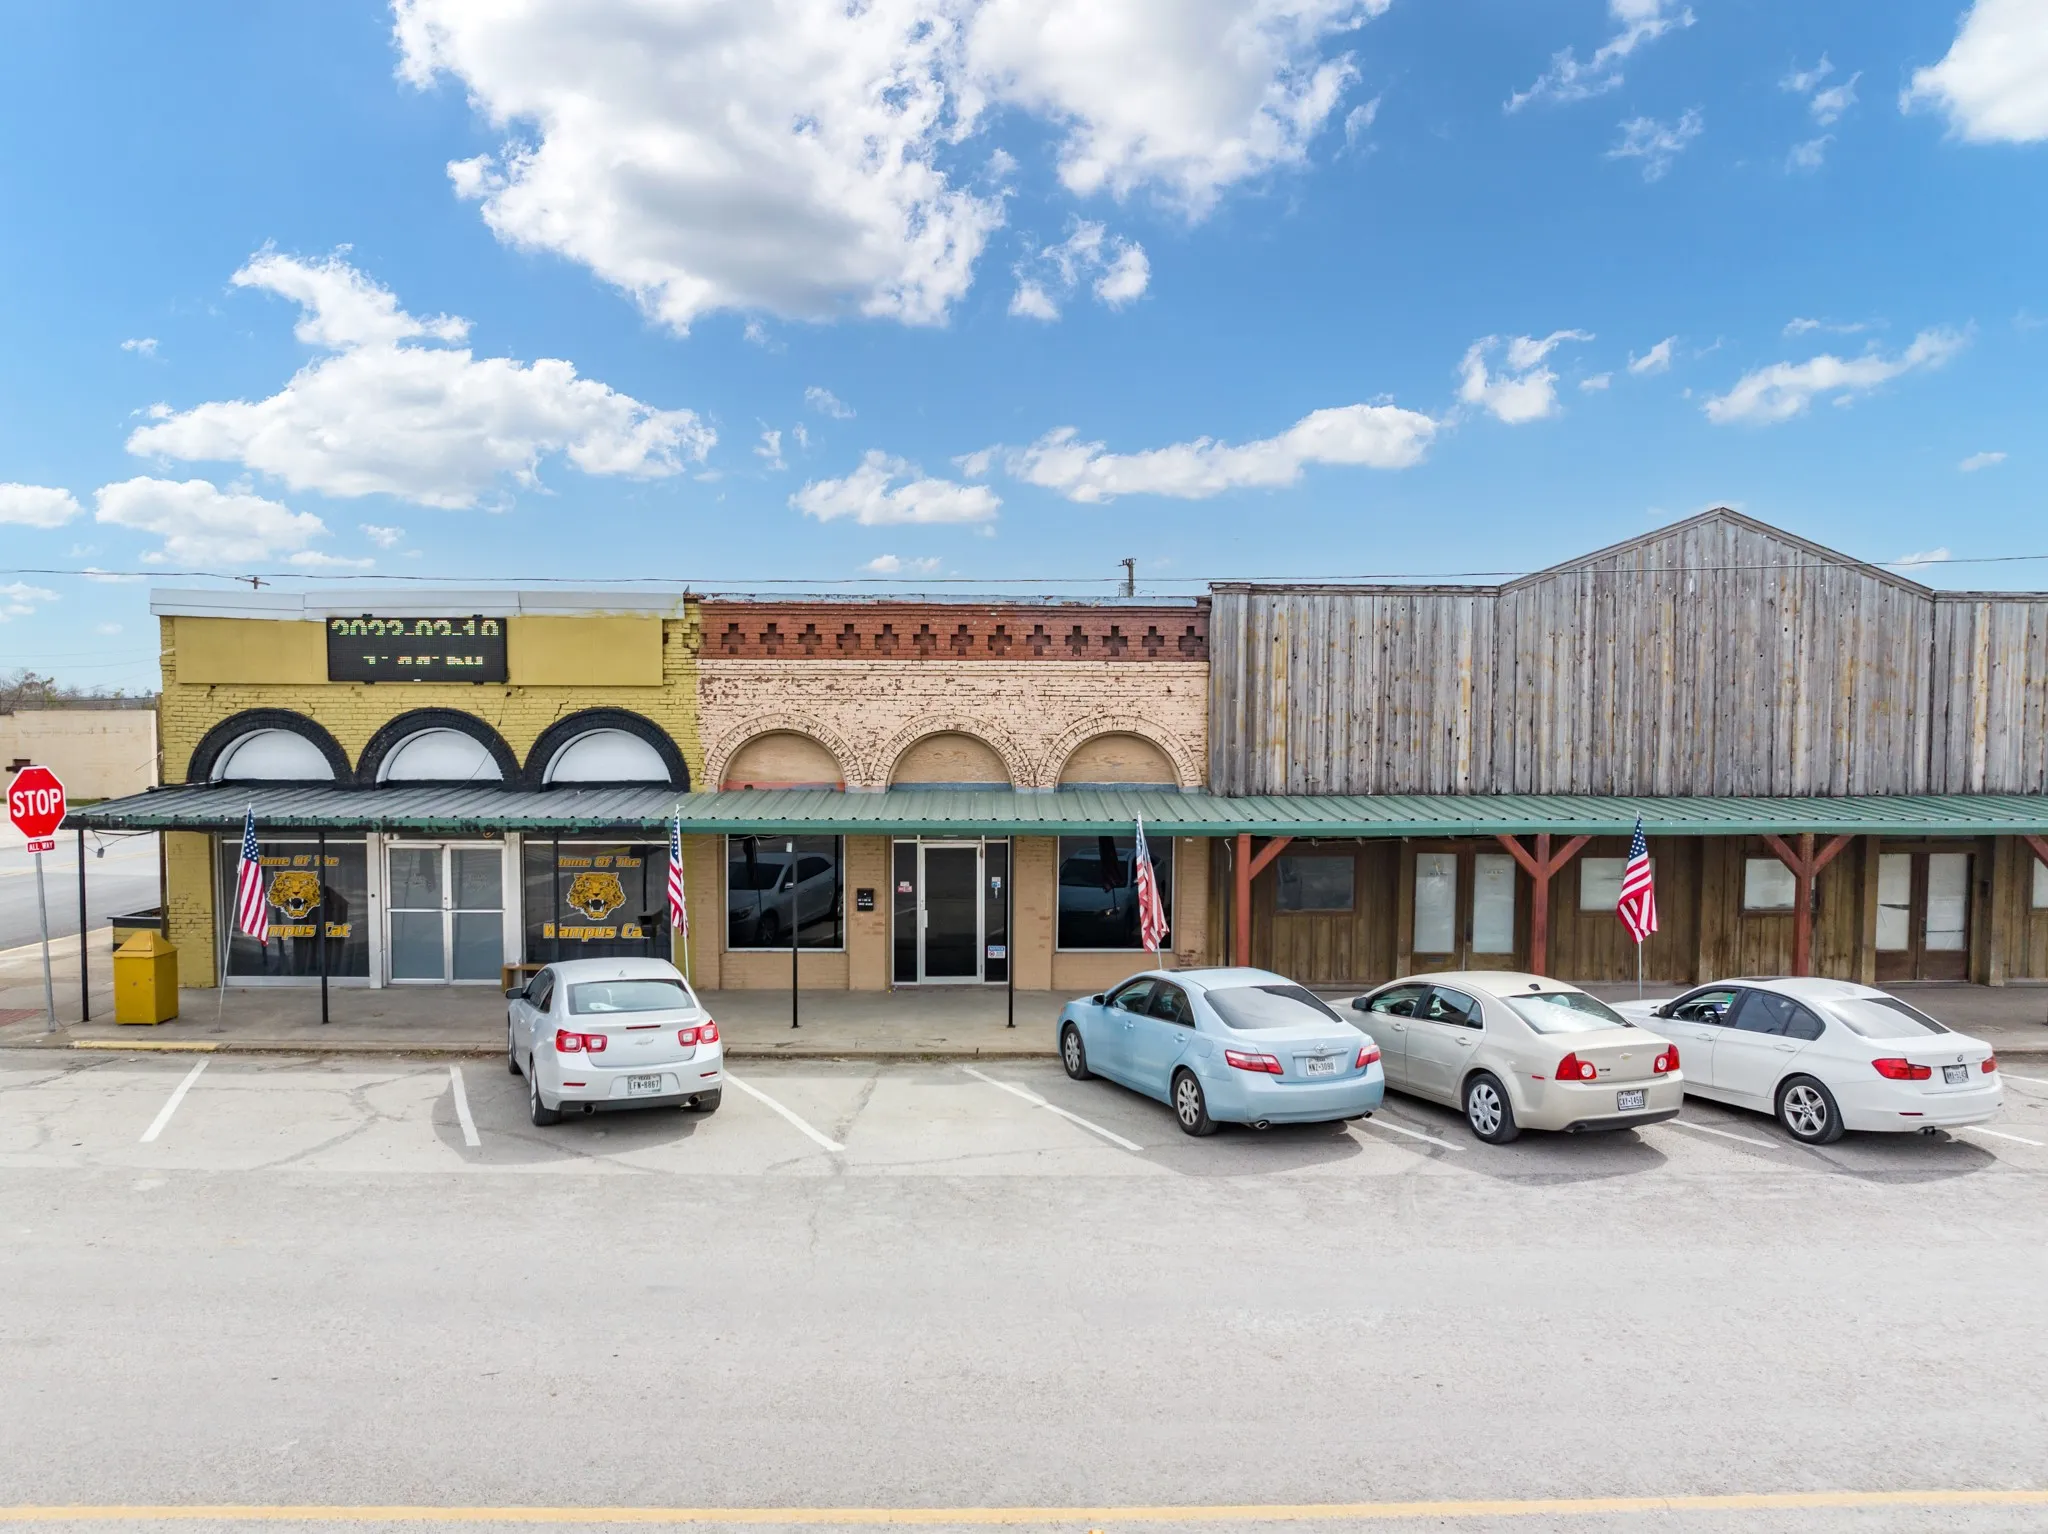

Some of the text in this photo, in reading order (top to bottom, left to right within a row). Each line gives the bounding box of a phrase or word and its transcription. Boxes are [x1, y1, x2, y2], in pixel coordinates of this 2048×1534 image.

[12, 788, 61, 817] STOP
[29, 841, 53, 851] ALL WAY
[293, 855, 312, 866] Of
[594, 856, 613, 868] Of
[616, 856, 641, 868] The
[267, 925, 316, 940] mpus
[621, 923, 649, 939] Ca
